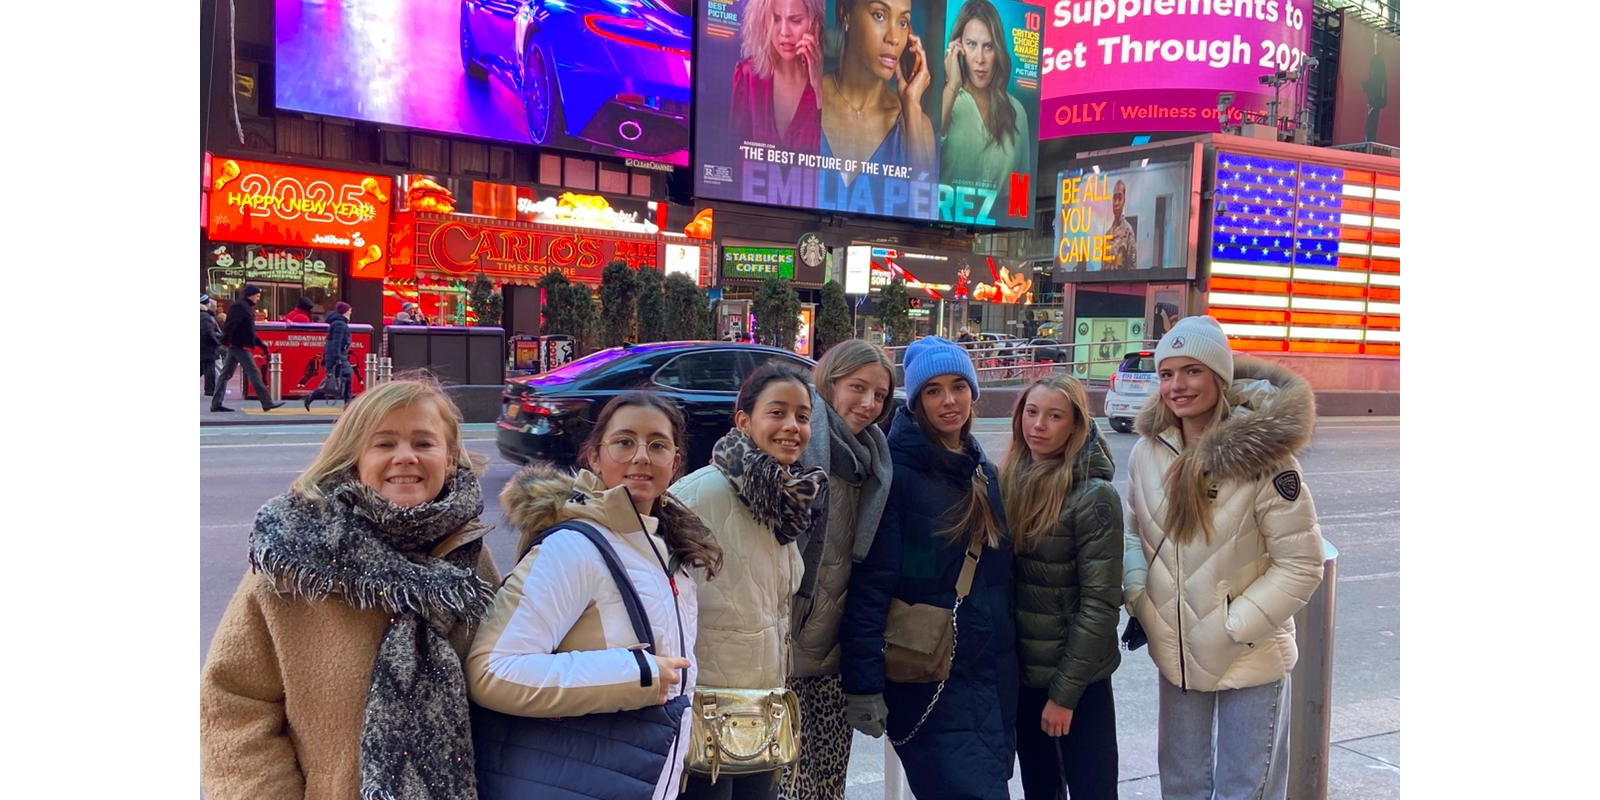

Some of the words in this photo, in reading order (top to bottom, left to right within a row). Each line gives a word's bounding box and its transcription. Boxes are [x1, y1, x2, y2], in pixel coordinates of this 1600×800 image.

[708, 1, 726, 11] BEST
[708, 10, 738, 21] PICTURE
[1053, 0, 1278, 27] Supplements
[1284, 0, 1303, 30] to
[1025, 12, 1040, 31] 10
[1012, 28, 1039, 40] CRITICS
[1014, 37, 1039, 48] CHOICE
[1013, 45, 1039, 56] AWARD
[1042, 41, 1087, 75] Get
[1098, 34, 1251, 68] Through
[1016, 68, 1038, 78] PICTURE
[1055, 101, 1107, 126] OLLY
[1120, 104, 1197, 120] Wellness
[1201, 107, 1221, 119] on
[767, 149, 795, 165] BEST
[798, 153, 842, 170] PICTURE
[844, 159, 858, 173] OF
[861, 161, 879, 175] THE
[239, 173, 366, 225] 2025
[742, 160, 876, 214] EMILIA
[884, 171, 998, 226] PÉREZ
[1008, 171, 1030, 218] N
[1062, 176, 1081, 205] BE
[1083, 174, 1113, 202] ALL
[228, 191, 284, 209] HAPPY
[290, 198, 327, 215] NEW
[1061, 207, 1093, 233] YOU
[312, 233, 350, 246] Jollibee
[428, 220, 605, 275] CARLO'S
[614, 240, 656, 257] BAKE
[1059, 236, 1090, 263] CAN
[1092, 234, 1116, 262] BE.
[245, 250, 326, 273] Jollibee
[496, 262, 530, 272] TIMES
[725, 252, 793, 263] STARBUCKS
[735, 263, 778, 273] COFFEE
